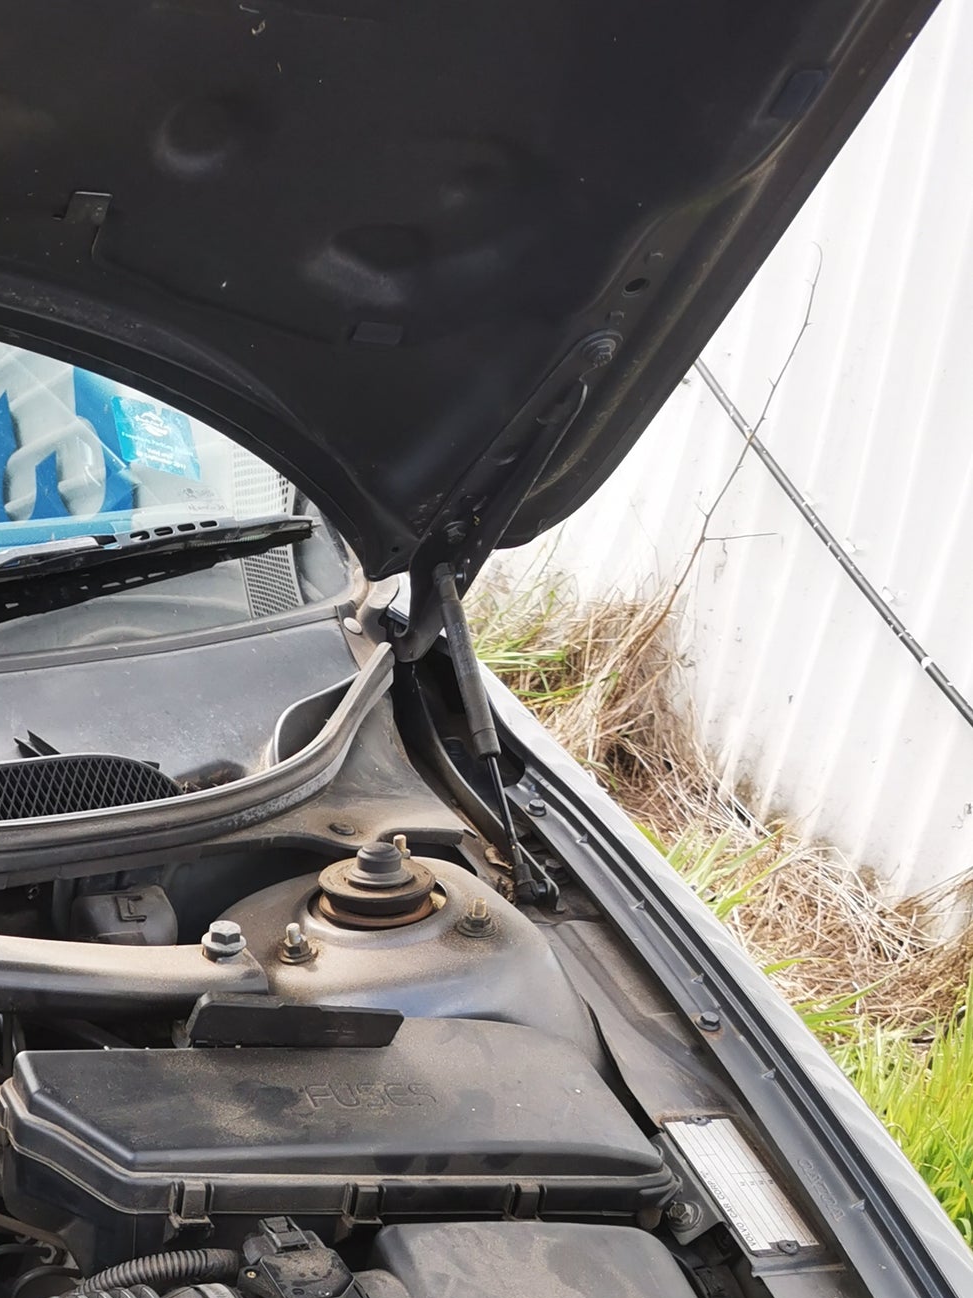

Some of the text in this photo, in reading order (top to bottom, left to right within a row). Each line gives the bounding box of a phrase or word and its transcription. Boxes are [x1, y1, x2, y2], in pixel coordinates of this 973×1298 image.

[300, 1083, 437, 1109] FUSES
[723, 1202, 738, 1219] CAR
[736, 1222, 757, 1247] VOLVO
